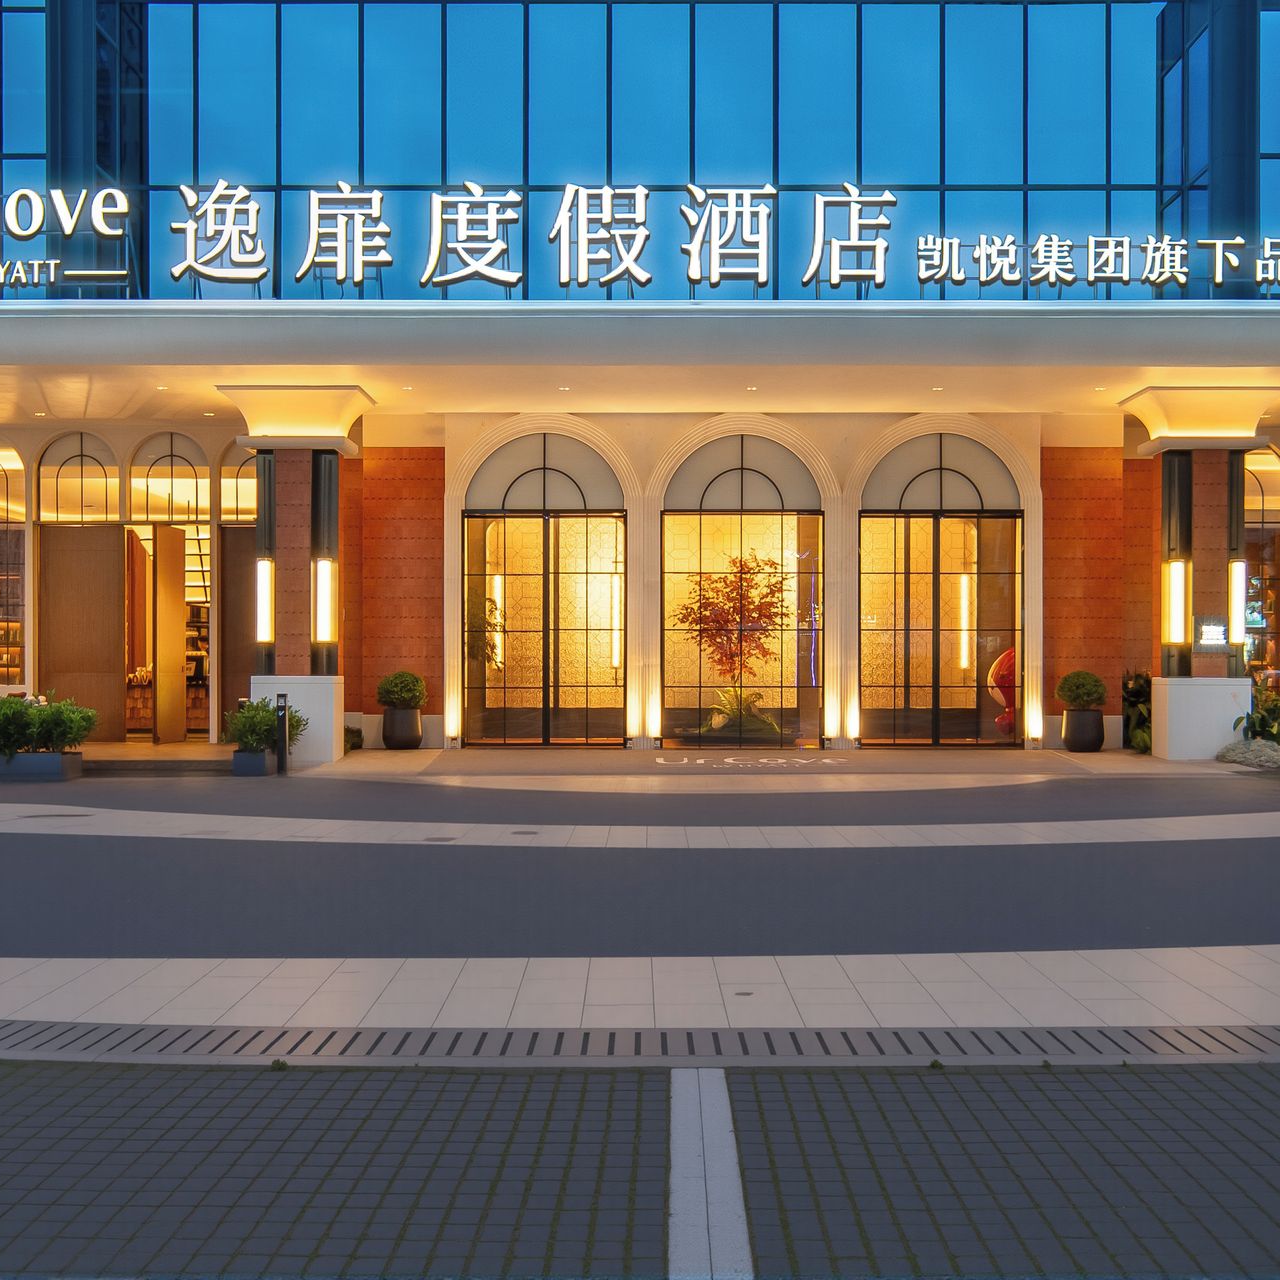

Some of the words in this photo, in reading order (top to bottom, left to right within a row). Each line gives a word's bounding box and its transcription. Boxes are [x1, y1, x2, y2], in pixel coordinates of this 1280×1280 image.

[170, 179, 898, 287] 逸扉度假酒店
